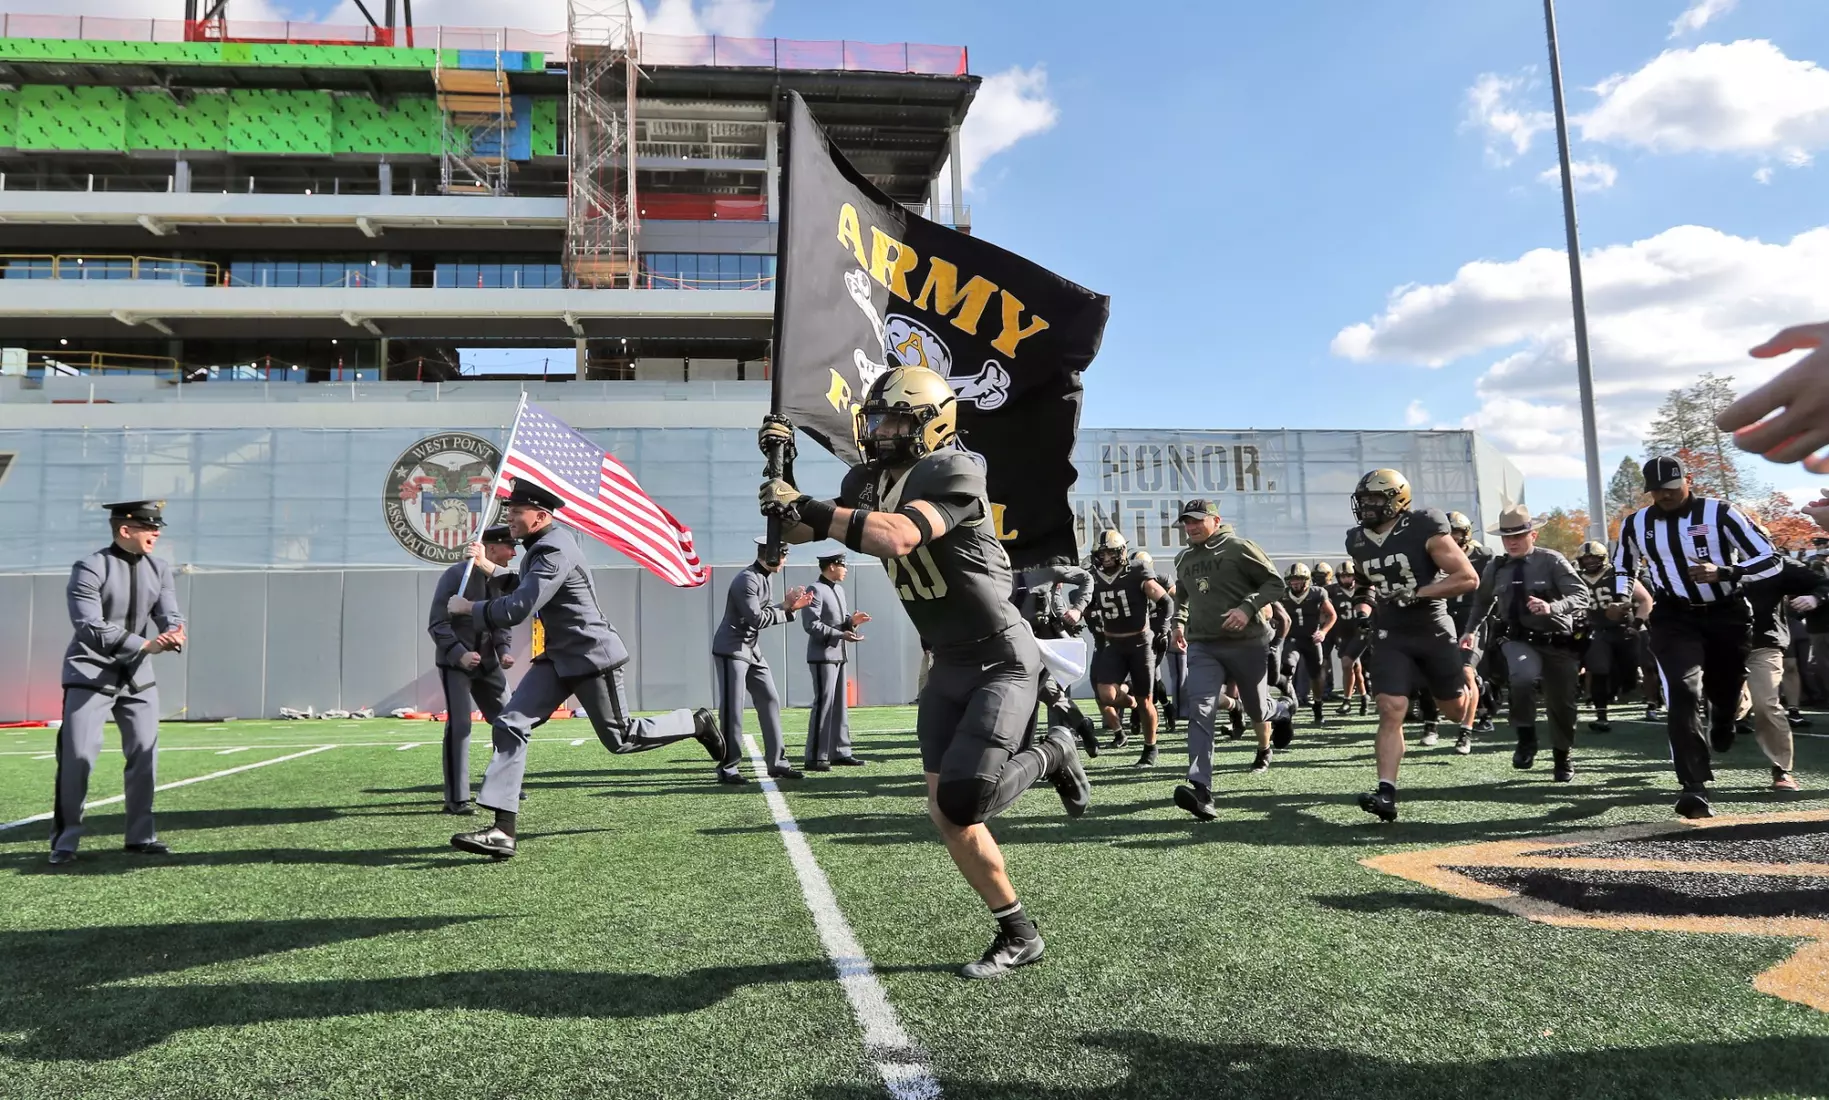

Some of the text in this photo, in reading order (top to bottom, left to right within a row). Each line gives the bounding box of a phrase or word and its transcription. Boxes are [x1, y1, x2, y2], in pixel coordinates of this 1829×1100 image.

[837, 203, 1050, 359] ARMY
[414, 437, 494, 458] WEST POINT
[387, 501, 461, 560] ASSOCIATION OF
[1401, 516, 1410, 527] C
[1646, 530, 1654, 540] S
[1696, 546, 1708, 558] H
[1184, 558, 1224, 578] ARMY
[1362, 553, 1418, 597] 53
[1100, 589, 1132, 620] 51
[1340, 601, 1357, 620] 3
